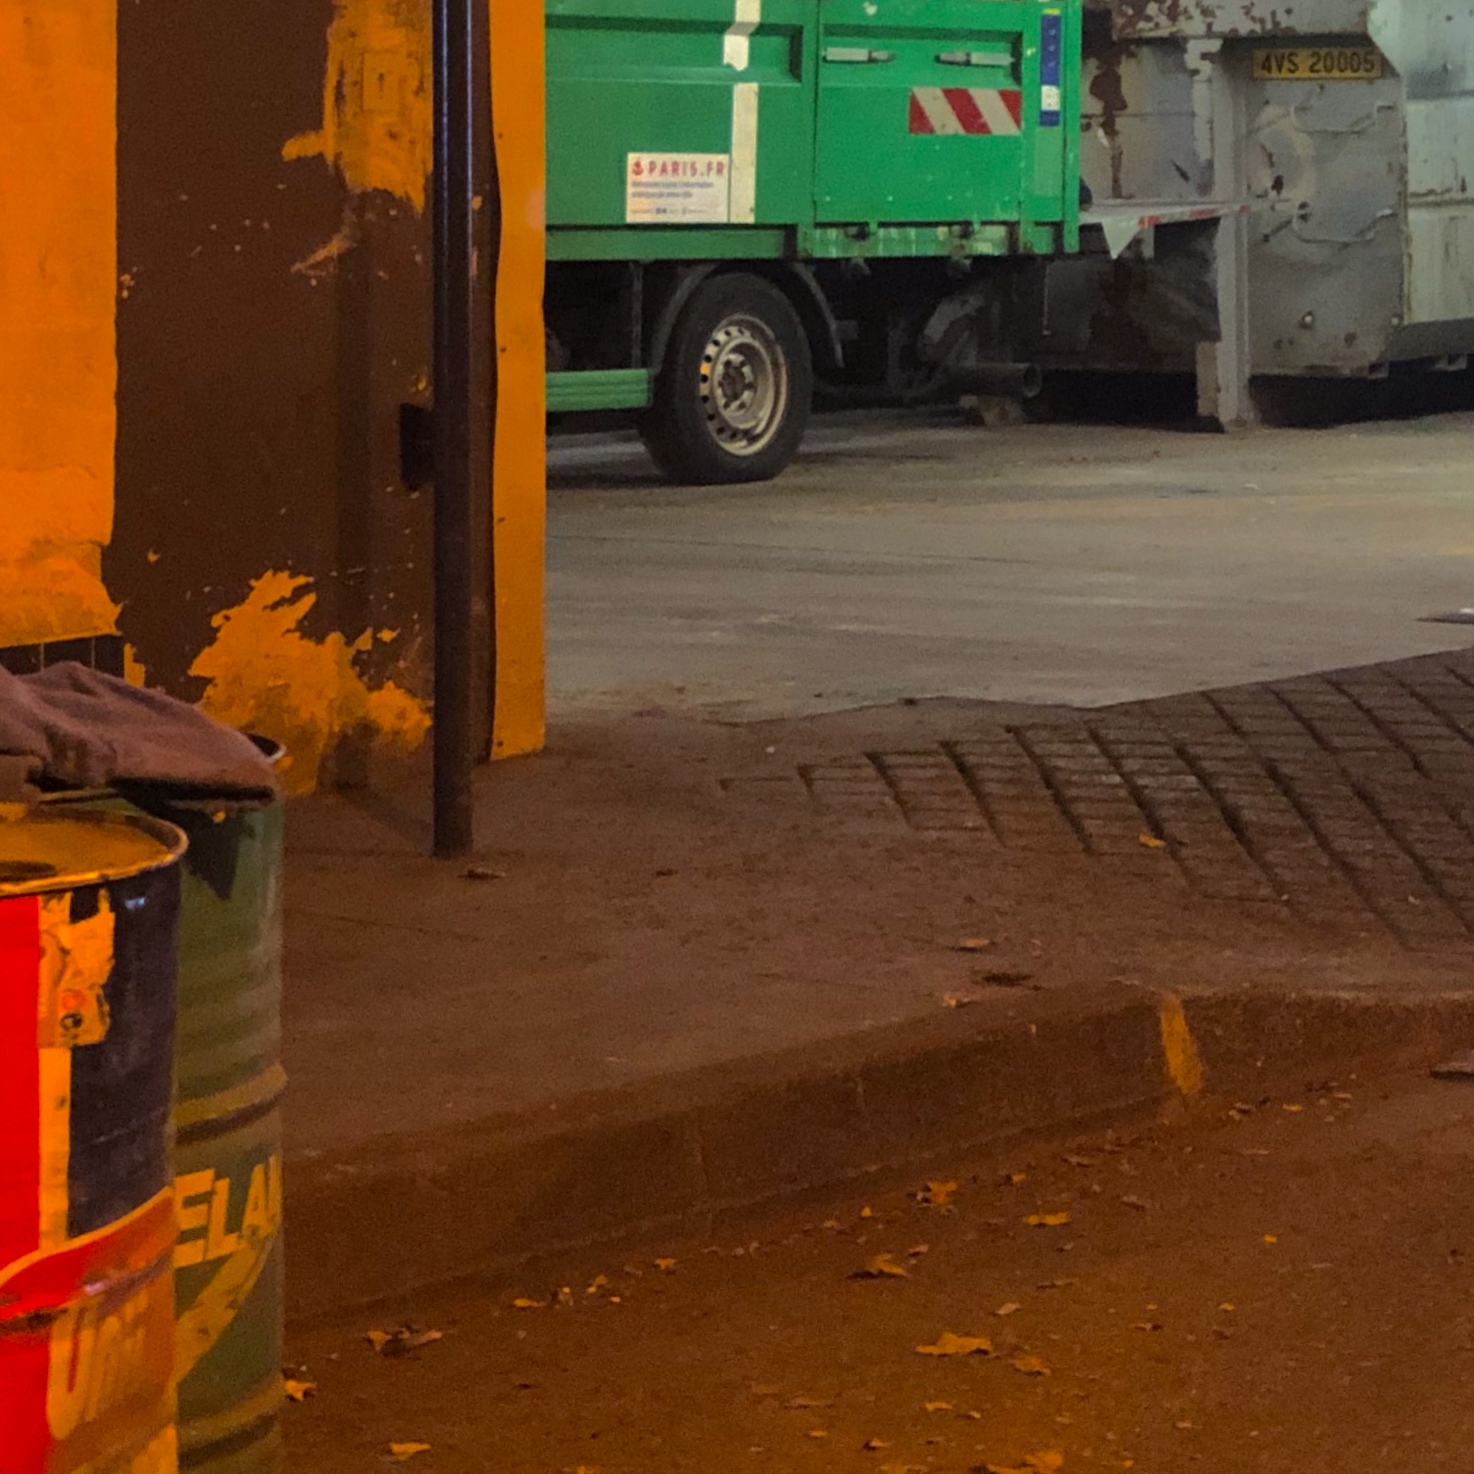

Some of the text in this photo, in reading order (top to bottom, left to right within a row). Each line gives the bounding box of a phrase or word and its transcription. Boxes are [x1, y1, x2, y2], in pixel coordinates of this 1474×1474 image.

[1260, 50, 1376, 75] 4VS 20005
[647, 160, 725, 178] PARIS.FR
